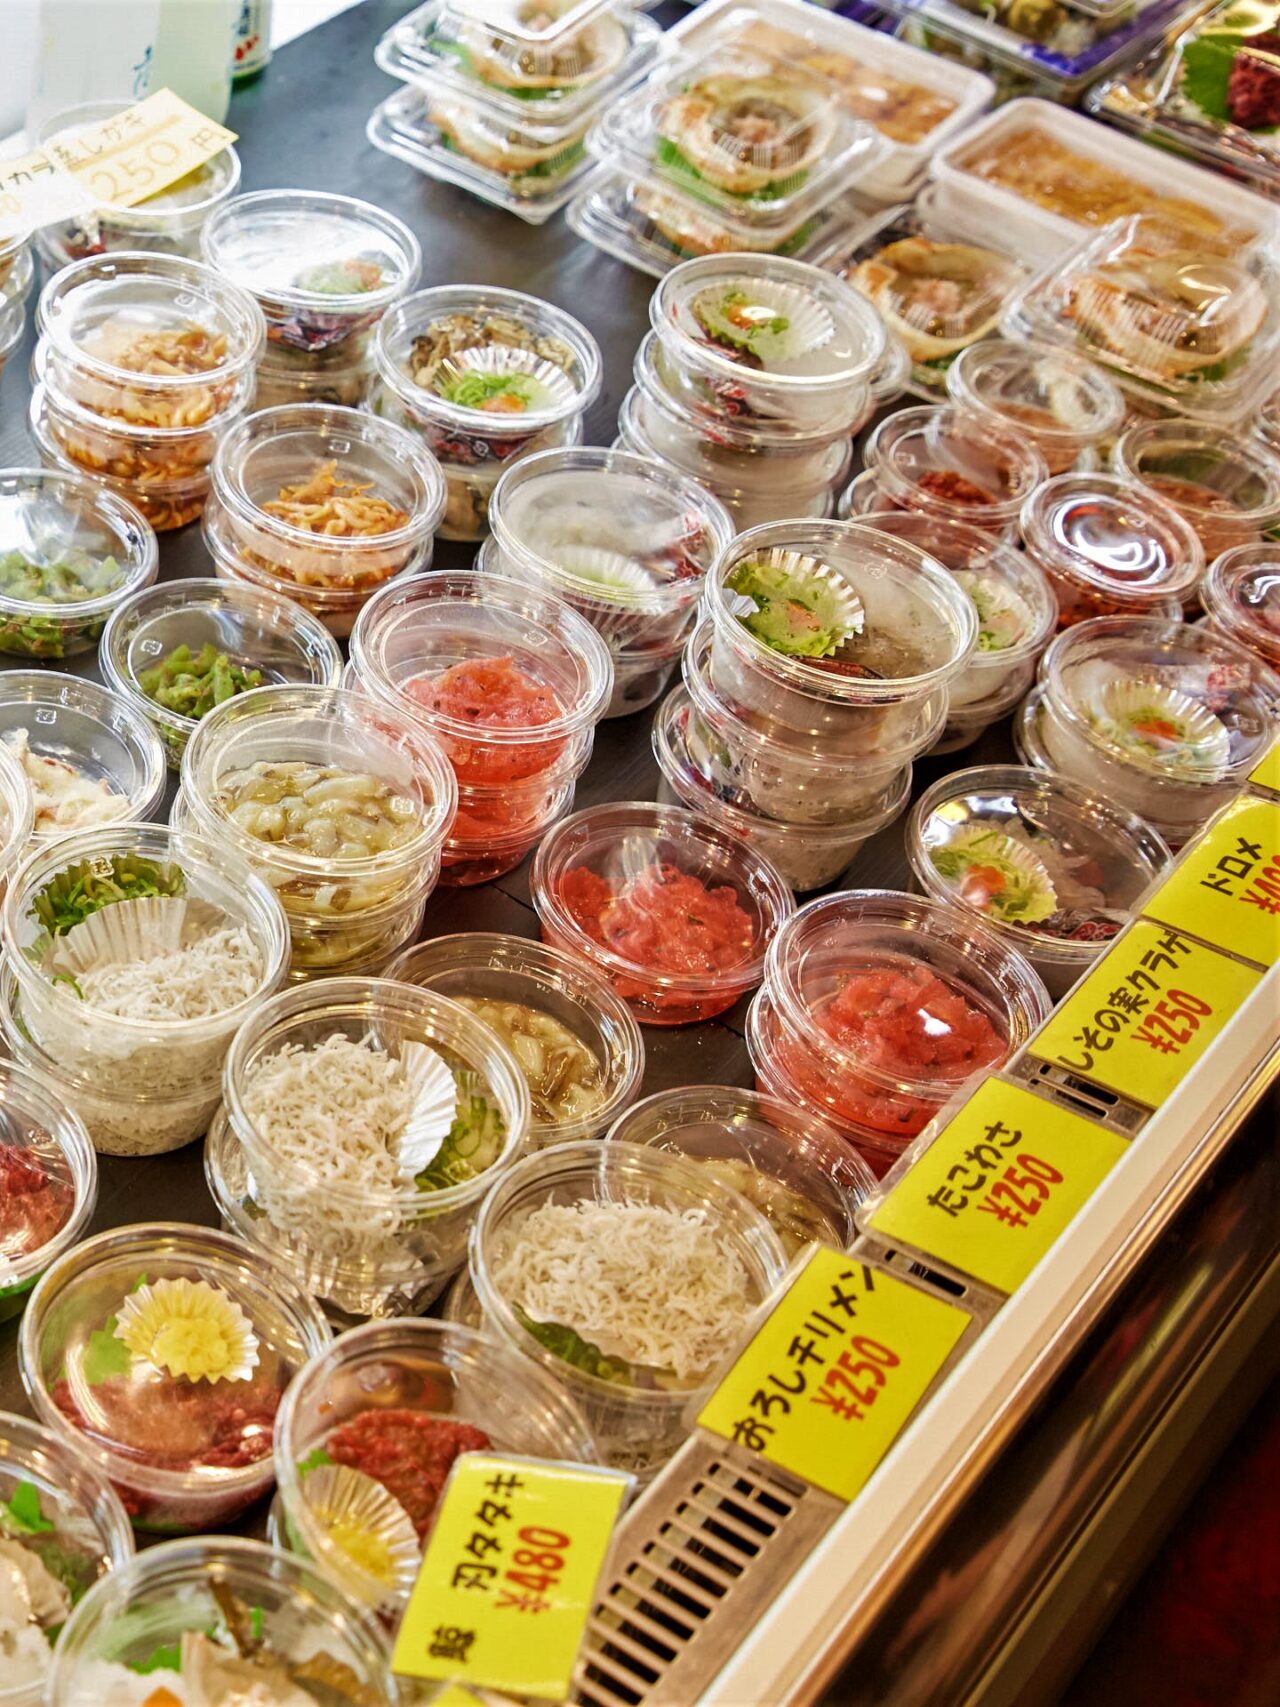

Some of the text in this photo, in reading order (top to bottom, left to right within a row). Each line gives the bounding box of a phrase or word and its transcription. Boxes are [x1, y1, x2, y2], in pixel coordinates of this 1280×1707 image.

[1199, 836, 1263, 897] ドロメ
[1057, 929, 1193, 1072] しその実クラゲ
[1129, 988, 1214, 1056] ¥250
[926, 1120, 1023, 1218] たこわさ
[975, 1153, 1065, 1229] ¥250
[731, 1265, 876, 1453] おろしチリメン
[809, 1334, 901, 1423] ¥250
[494, 1524, 571, 1616] ¥480
